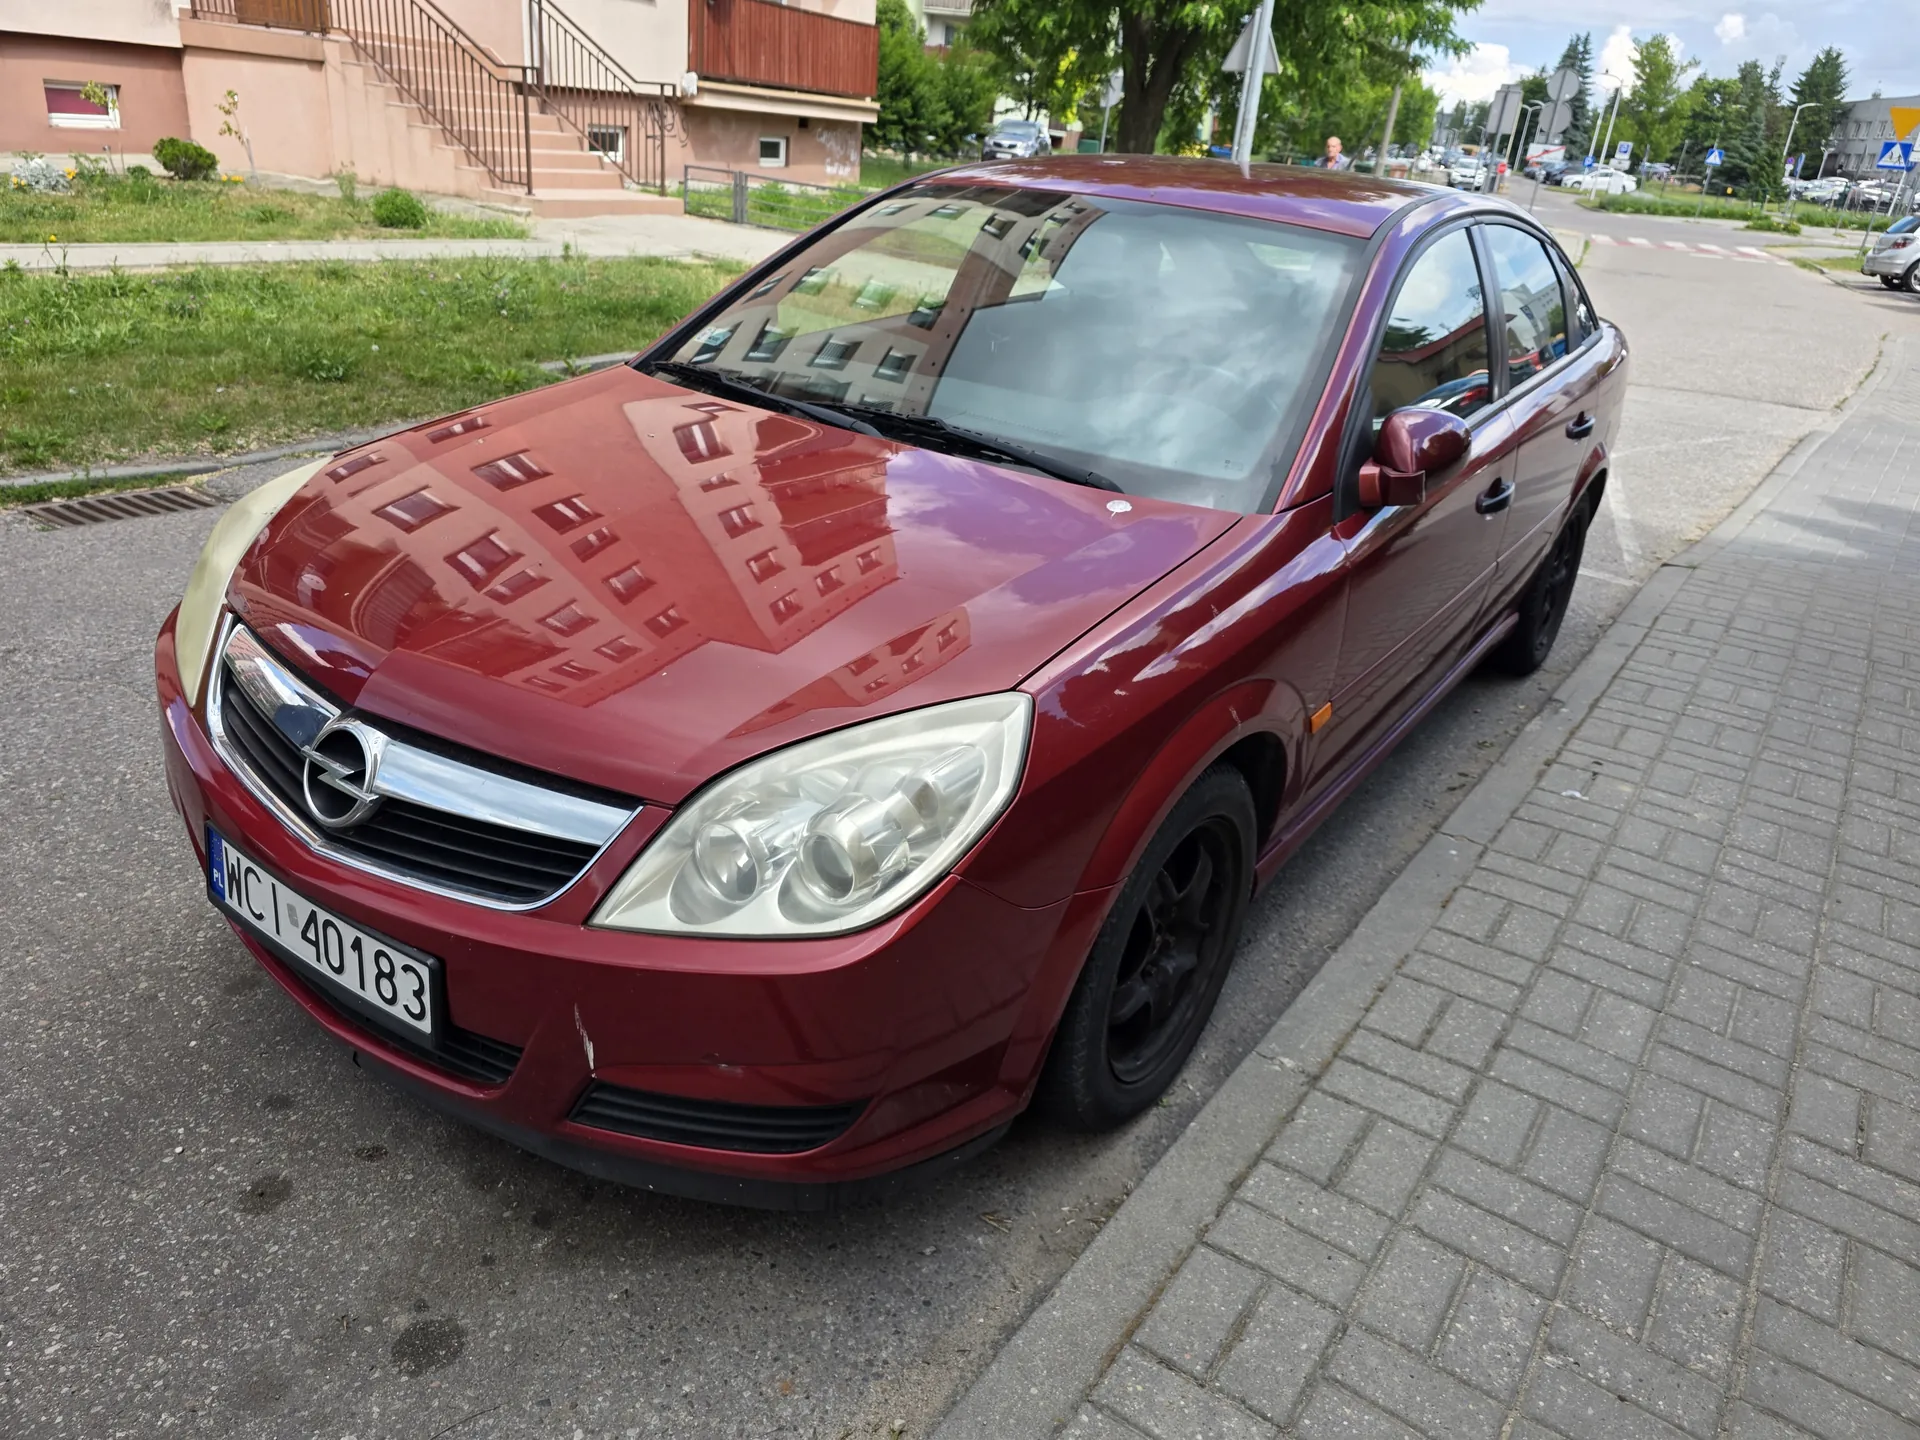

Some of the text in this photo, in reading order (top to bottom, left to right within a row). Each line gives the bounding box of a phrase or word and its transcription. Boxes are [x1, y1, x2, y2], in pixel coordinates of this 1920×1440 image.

[213, 868, 224, 889] PL
[224, 846, 426, 1021] WCI 40183
